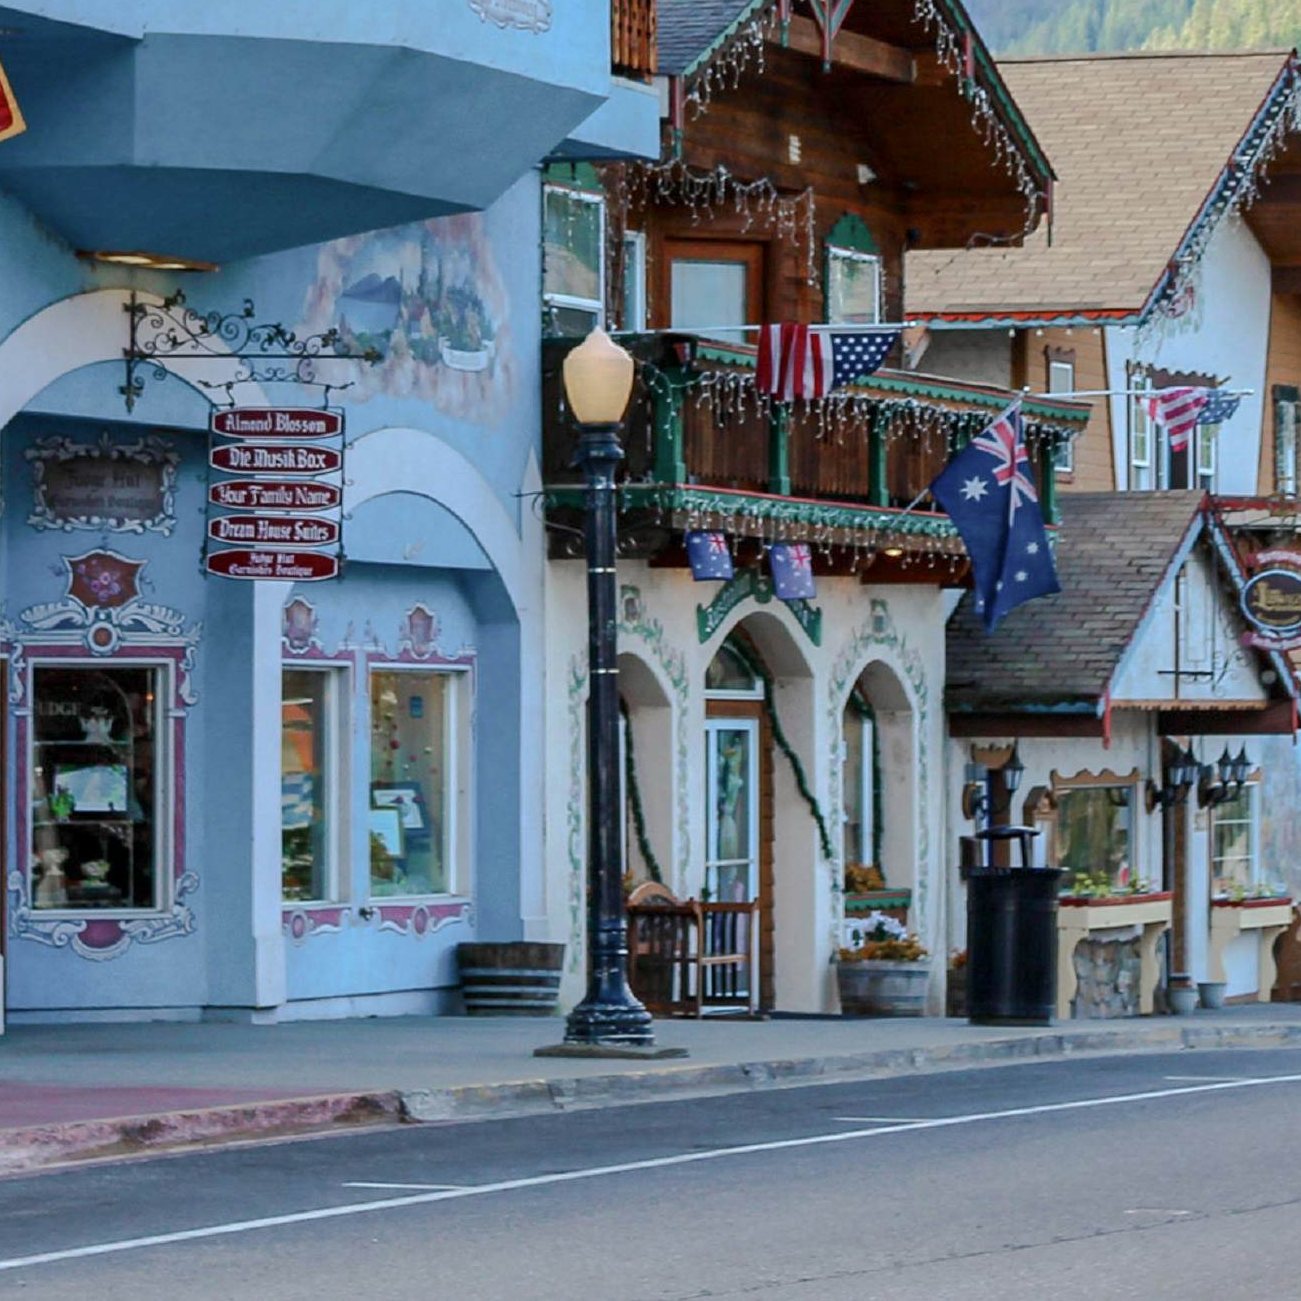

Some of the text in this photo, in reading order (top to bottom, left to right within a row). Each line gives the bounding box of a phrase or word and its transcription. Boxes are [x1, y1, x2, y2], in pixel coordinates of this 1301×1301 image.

[225, 411, 327, 433] Almond Blossom
[228, 447, 327, 469] Die Musik Box
[218, 485, 331, 506] Your Family Name
[219, 519, 330, 541] Dream House Suites
[37, 701, 82, 716] UDGE
